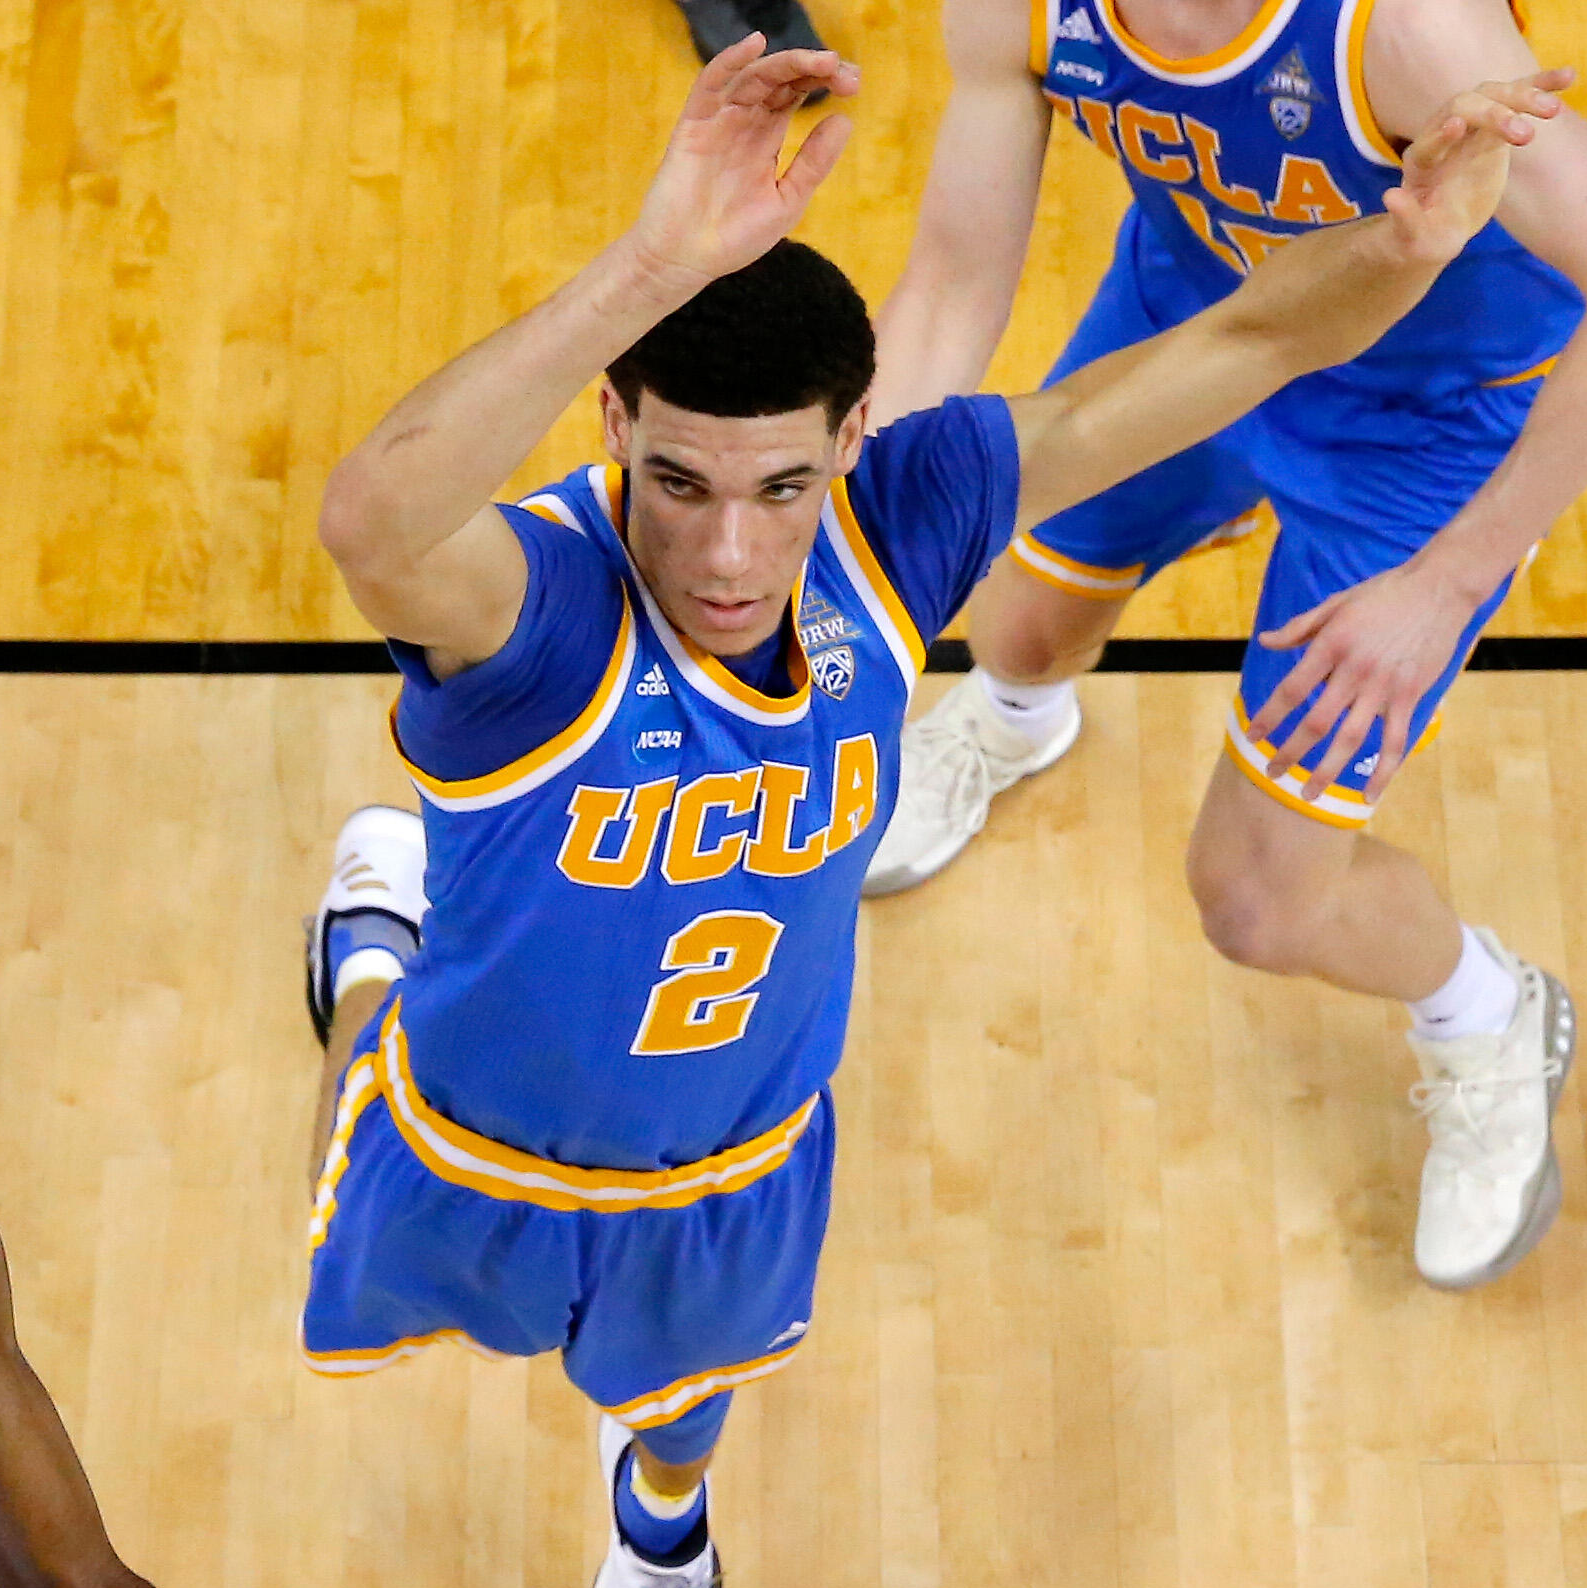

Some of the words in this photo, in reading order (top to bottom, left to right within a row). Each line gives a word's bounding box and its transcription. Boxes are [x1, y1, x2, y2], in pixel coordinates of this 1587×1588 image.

[555, 731, 879, 890] UCLA
[635, 729, 683, 750] NCAA
[629, 908, 785, 1057] 2
